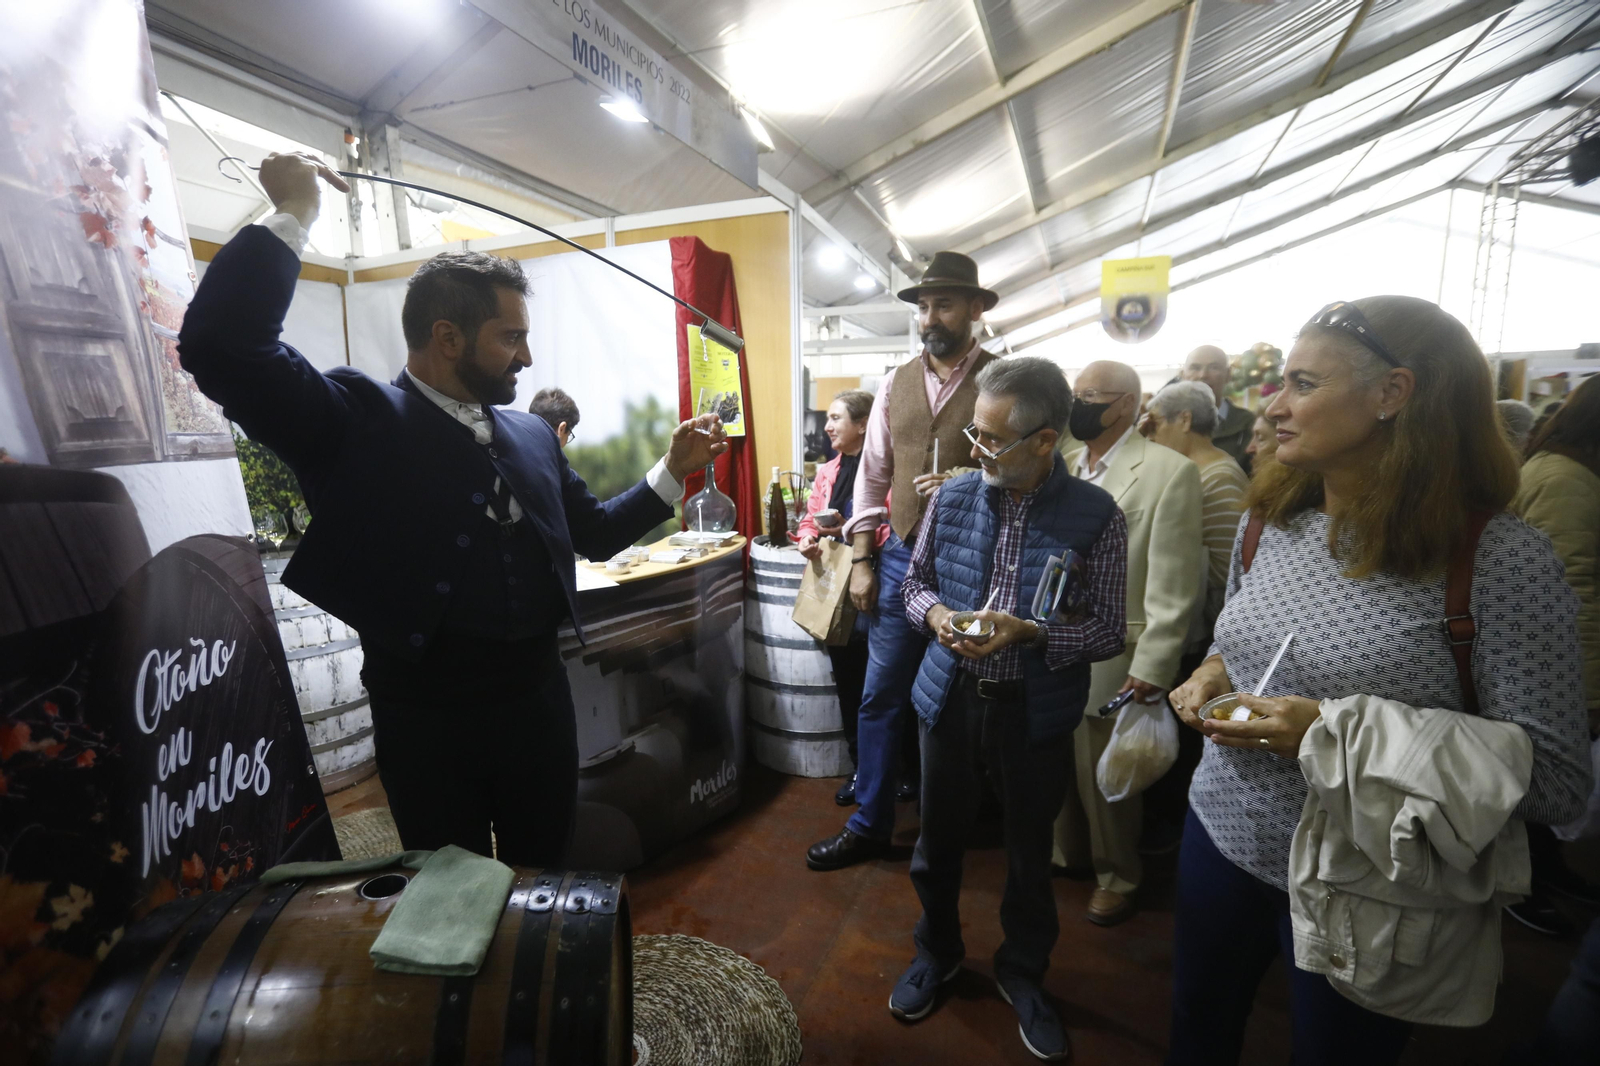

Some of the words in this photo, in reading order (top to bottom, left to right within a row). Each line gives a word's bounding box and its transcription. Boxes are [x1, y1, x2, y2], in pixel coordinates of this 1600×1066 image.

[564, 0, 591, 29] LOS
[594, 17, 664, 84] MUNICIPIOS
[669, 76, 691, 104] 2022
[572, 31, 643, 104] MORILES
[135, 636, 237, 735] Otoño
[158, 726, 192, 782] en
[690, 759, 738, 805] Moriles
[142, 737, 275, 879] Moriles
